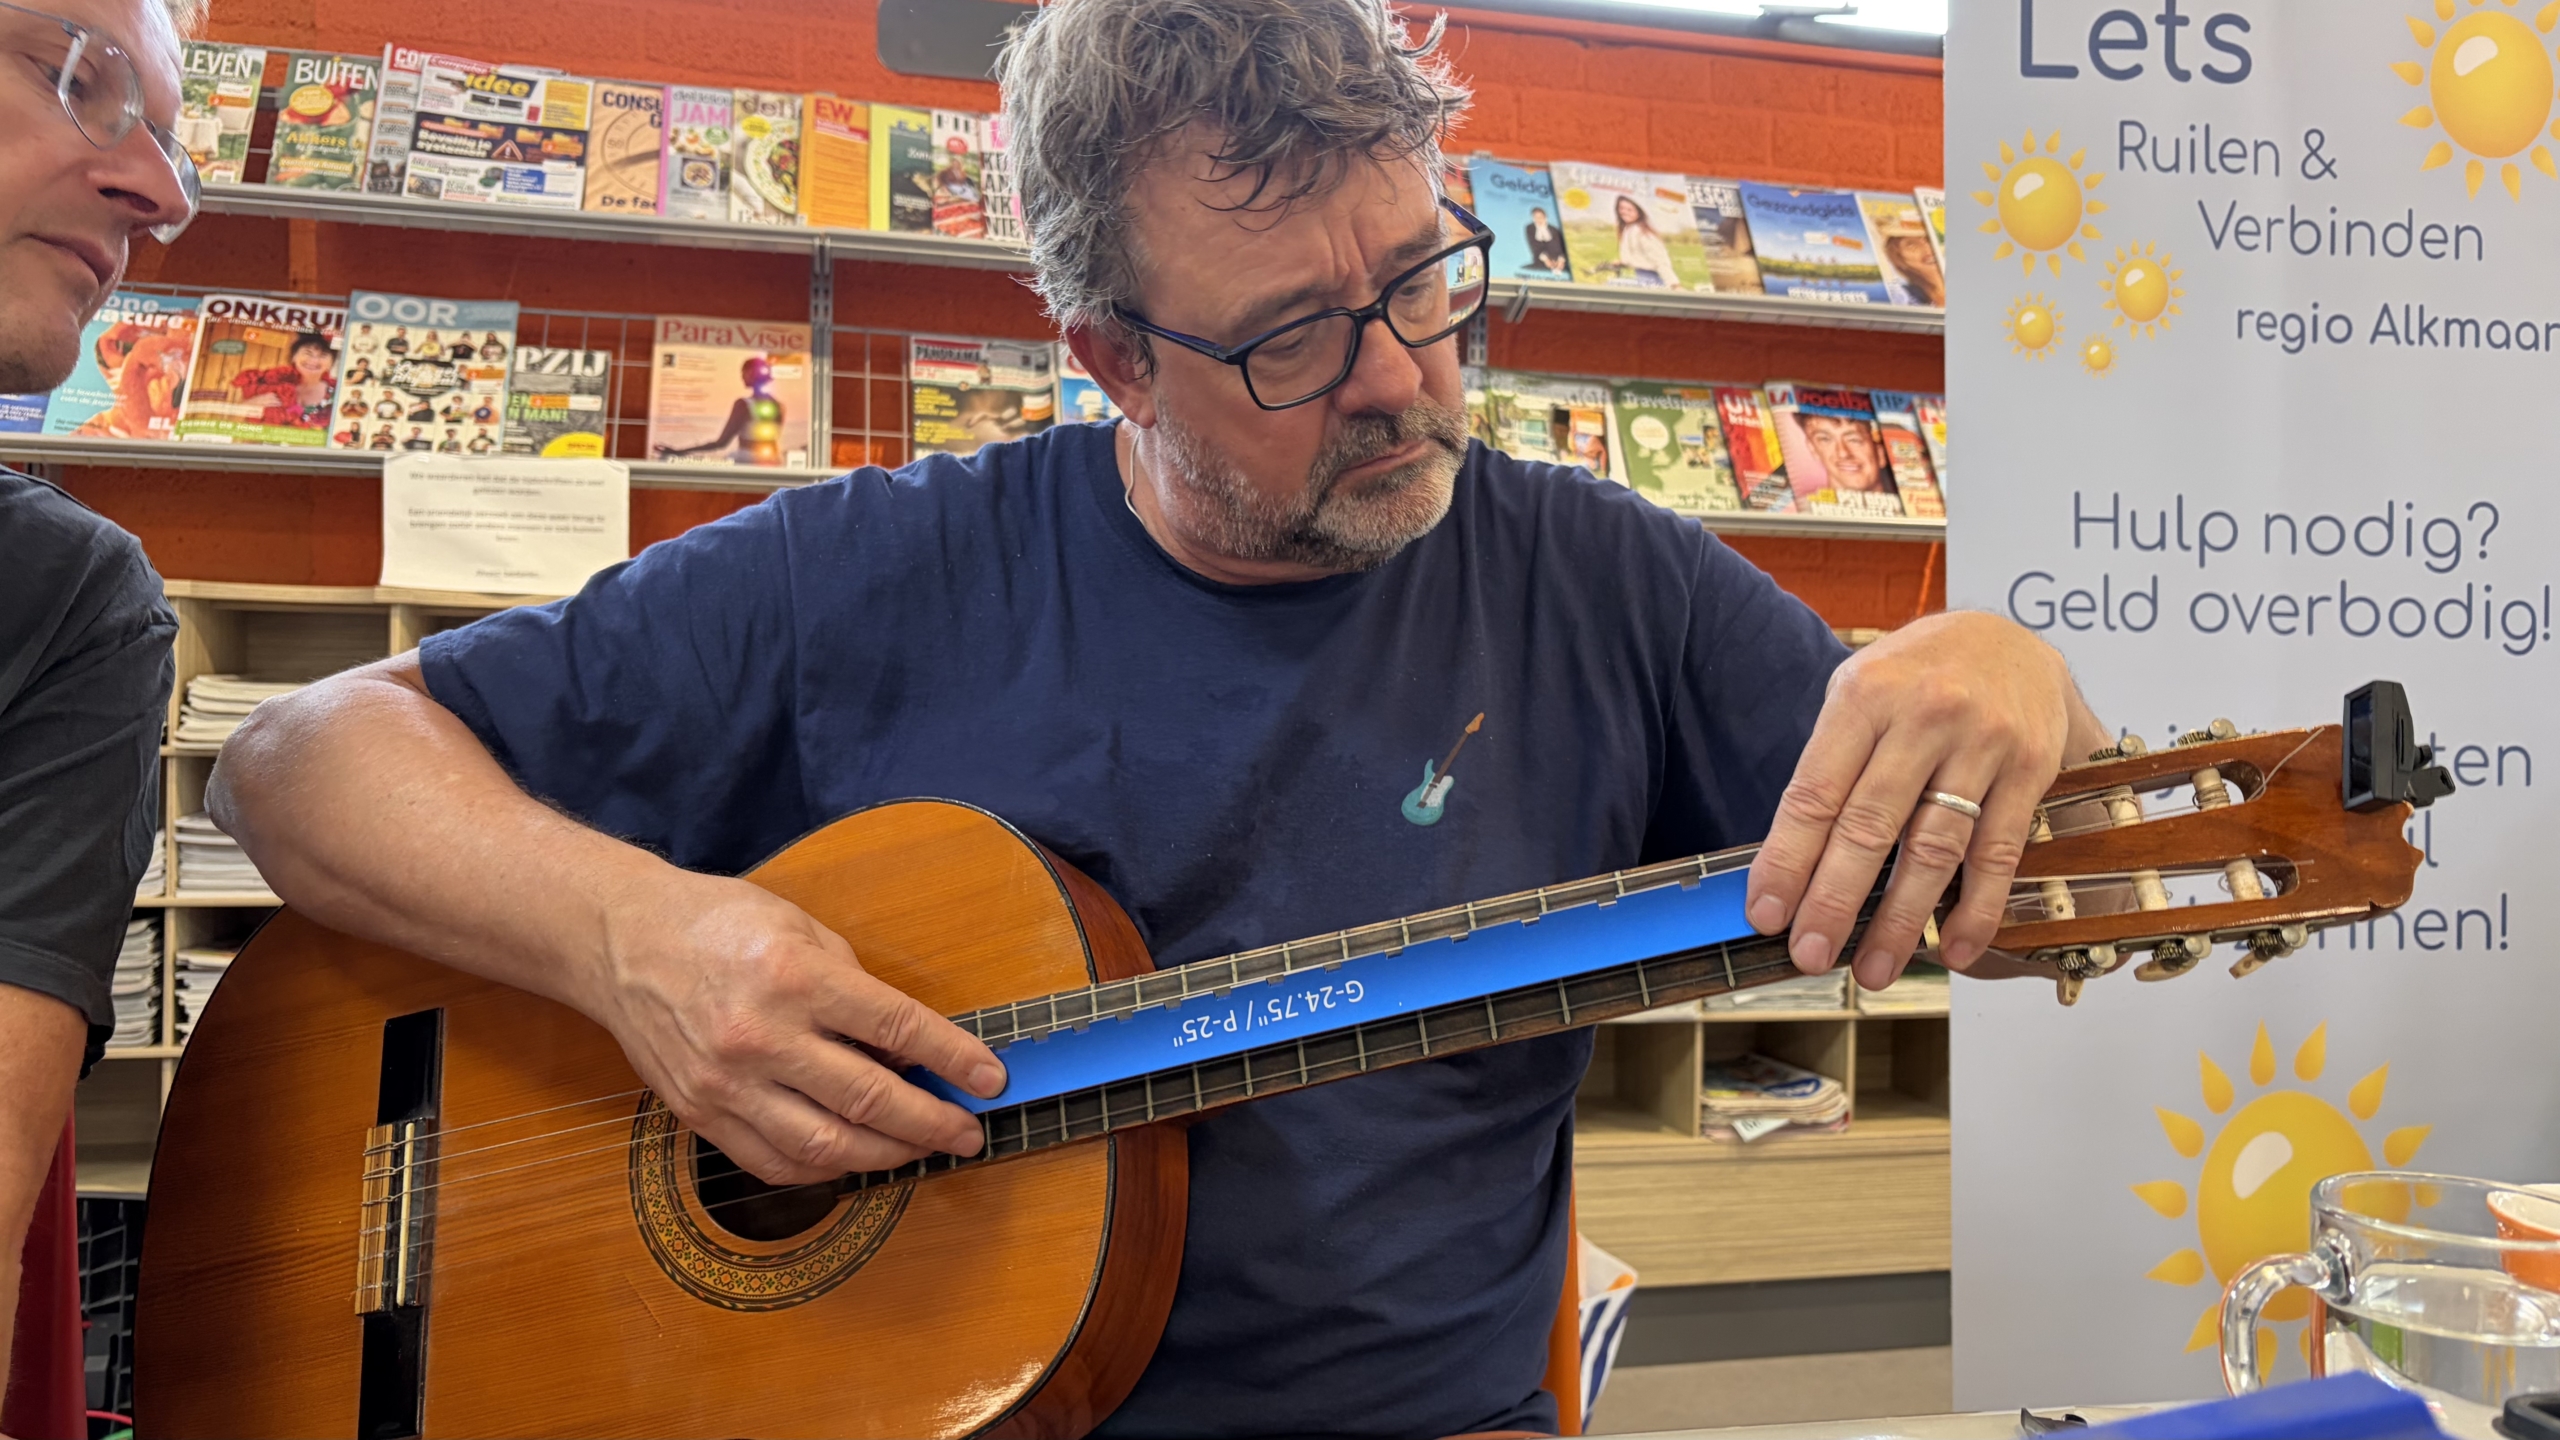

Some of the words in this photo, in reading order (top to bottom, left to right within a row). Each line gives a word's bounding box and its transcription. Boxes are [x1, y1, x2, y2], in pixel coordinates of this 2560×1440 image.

[182, 47, 253, 78] LEVEN
[2020, 0, 2252, 84] Lets
[294, 56, 380, 90] BUITEN
[465, 74, 530, 98] idee
[2118, 119, 2281, 178] Ruilen
[2301, 128, 2338, 180] &
[2198, 199, 2483, 262] Verbinden
[355, 293, 459, 327] OOR
[2237, 302, 2353, 354] regio
[2369, 303, 2560, 352] Alkmaar
[2073, 491, 2239, 568] Hulp
[2263, 500, 2500, 573] nodig?
[2008, 571, 2158, 633] Geld
[2190, 580, 2551, 656] overbodig!
[1173, 1009, 1238, 1048] P-25"
[1258, 980, 1364, 1028] G-24.75"
